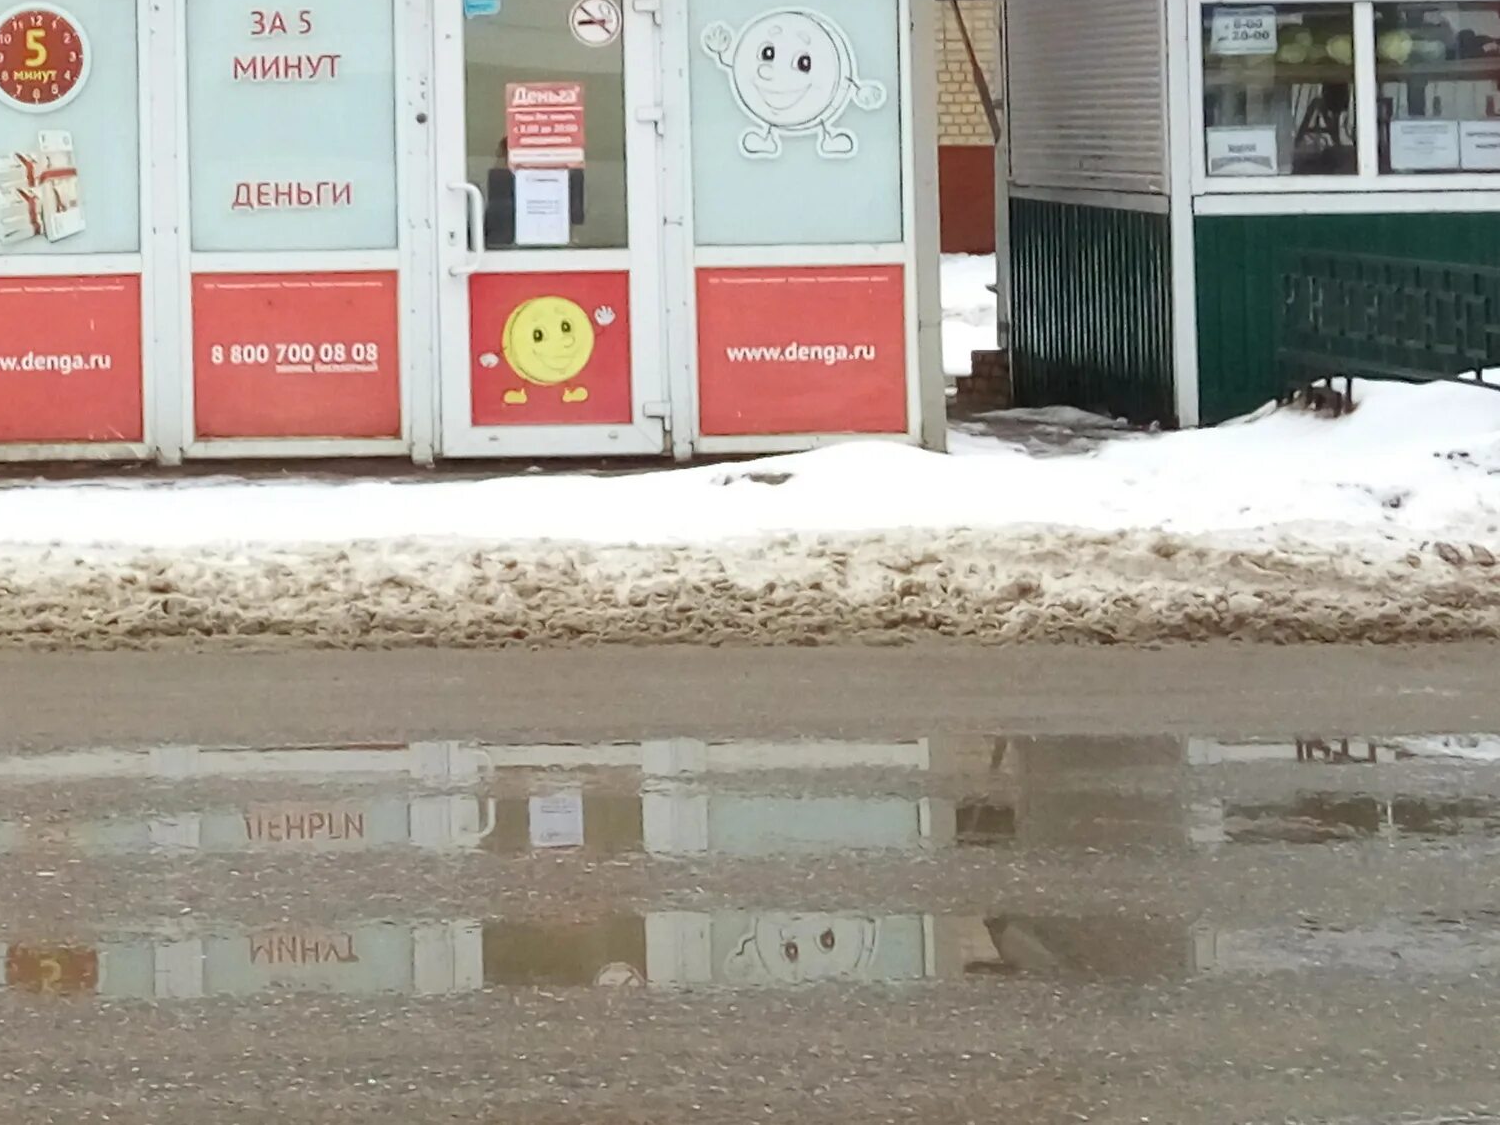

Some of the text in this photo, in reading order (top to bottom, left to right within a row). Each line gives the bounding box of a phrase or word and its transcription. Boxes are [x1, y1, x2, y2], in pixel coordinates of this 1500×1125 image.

[250, 10, 312, 35] ЗА 5
[25, 28, 47, 67] 5
[13, 71, 57, 83] минут
[233, 54, 341, 80] МИНУТ
[231, 181, 352, 210] ДЕНЬГИ
[211, 343, 378, 364] 8 800 700 08 08
[726, 342, 876, 365] www.denga.ru
